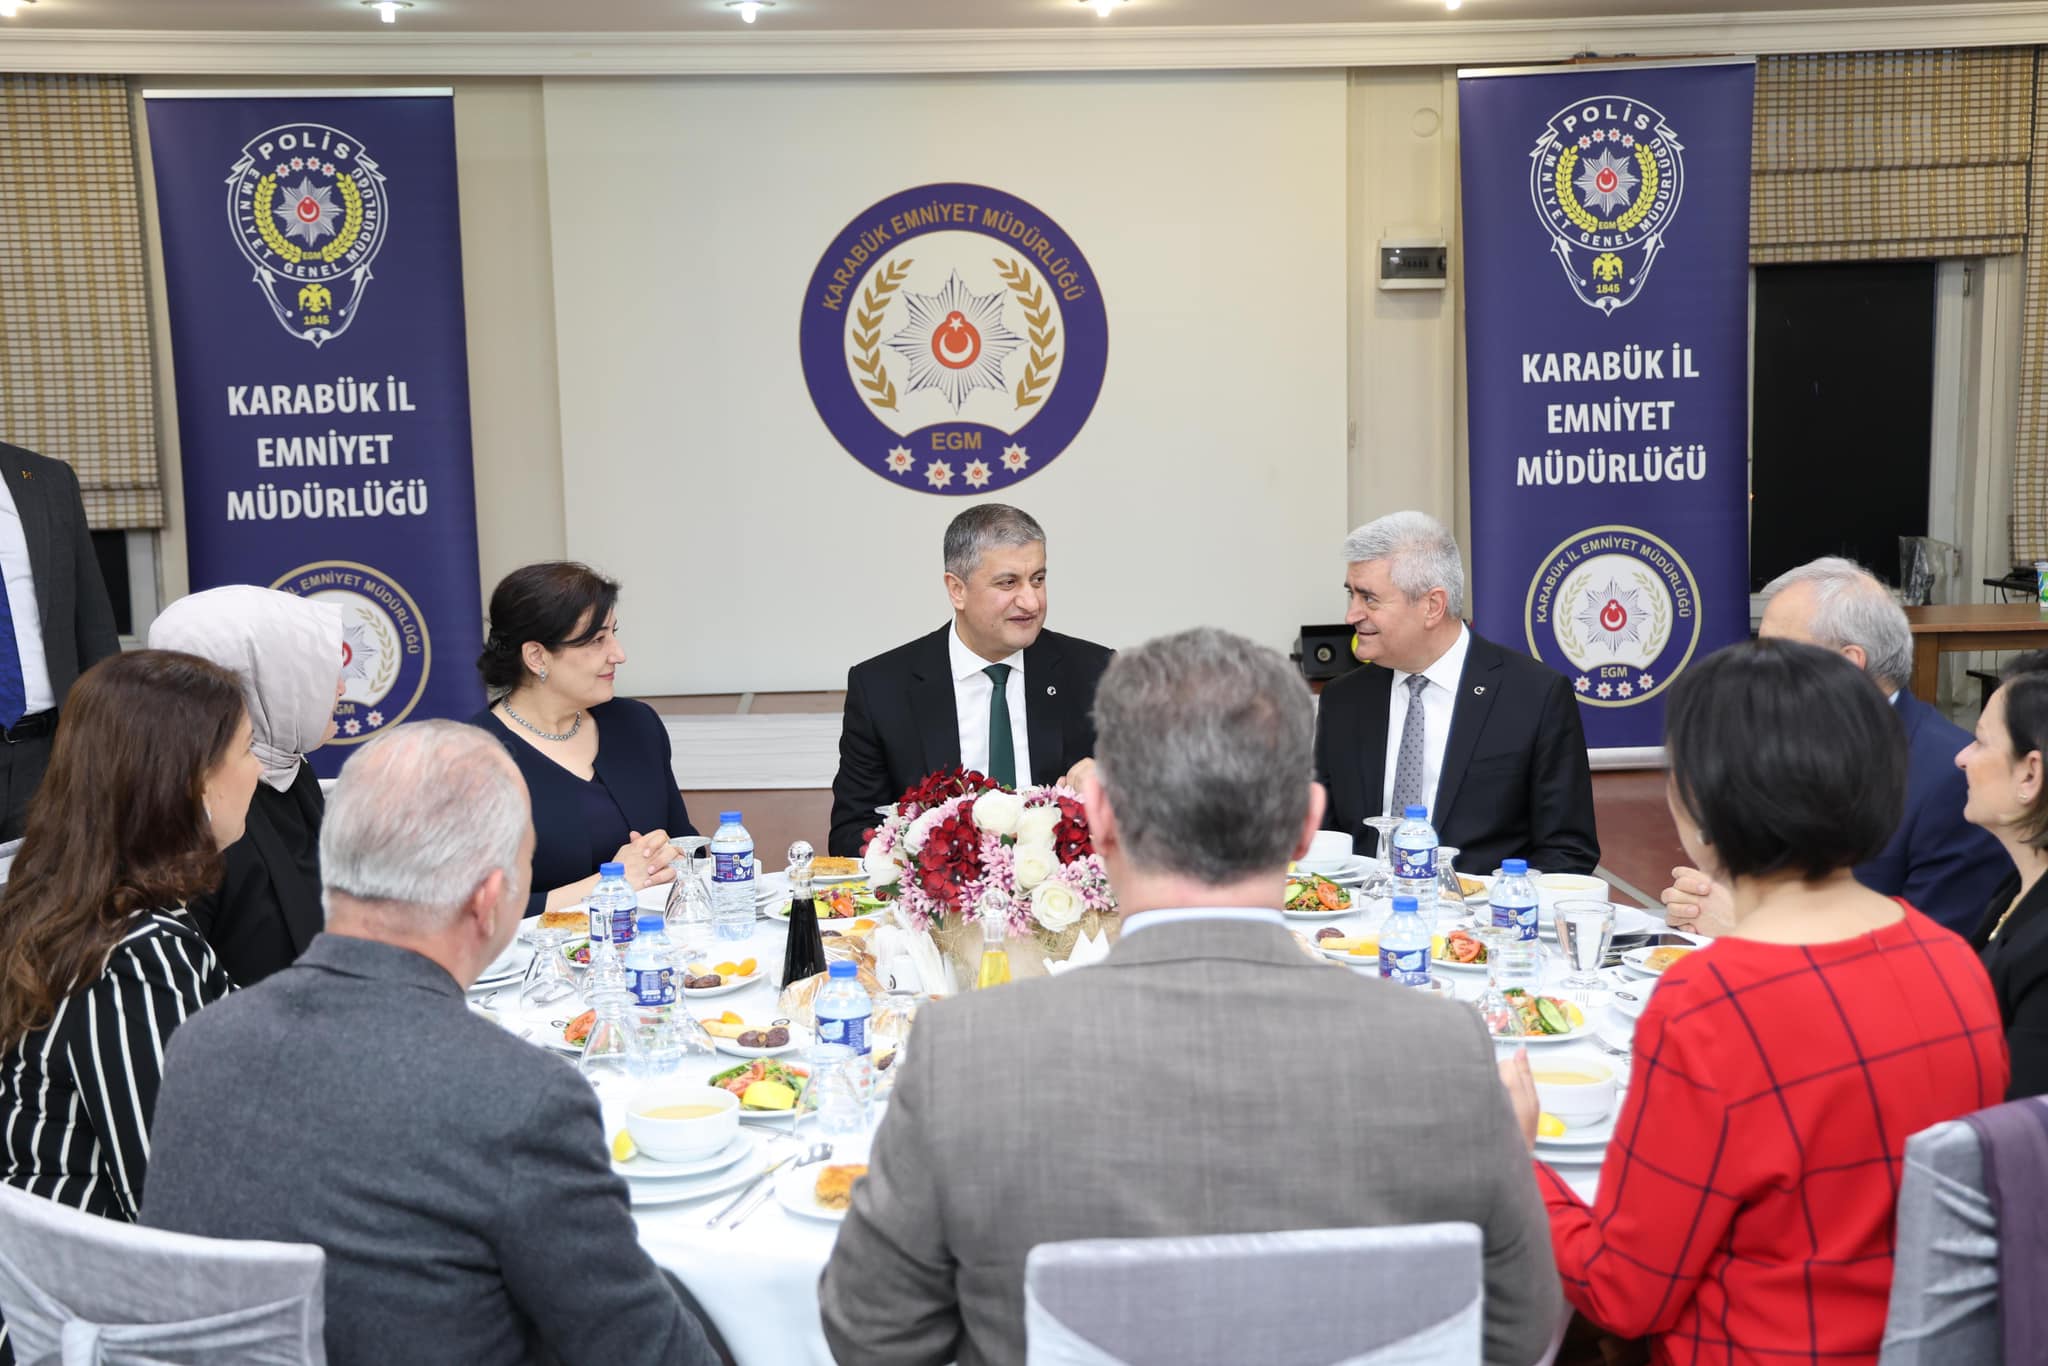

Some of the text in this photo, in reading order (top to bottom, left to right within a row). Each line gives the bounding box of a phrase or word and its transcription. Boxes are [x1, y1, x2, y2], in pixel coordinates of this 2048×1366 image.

[1562, 103, 1651, 133] POLİS
[258, 131, 351, 160] POLİS
[1542, 137, 1673, 247] EMNİYET GENEL MÜDÜRLÜĞÜ
[284, 262, 342, 277] GENEL
[821, 200, 1087, 311] KARABÜK EMNİYET MÜDÜRLÜĞÜ
[1596, 284, 1620, 294] 1845
[303, 315, 330, 325] 1845
[1522, 342, 1700, 383] KARABÜK İL
[227, 375, 416, 416] KARABÜK İL
[1547, 396, 1675, 434] EMNİYET
[257, 429, 393, 468] EMNİYET
[931, 431, 982, 450] EGM
[1516, 444, 1706, 486] MÜDÜRLÜĞÜ
[227, 478, 428, 521] MÜDÜRLÜĞÜ
[1537, 535, 1692, 623] KARABÜK İL EMNİYET MÜDÜRLÜĞÜ
[300, 570, 361, 591] EMNİYET
[363, 580, 420, 654] MÜDÜRLÜĞÜ
[1601, 666, 1628, 678] EGM
[336, 703, 355, 714] GM
